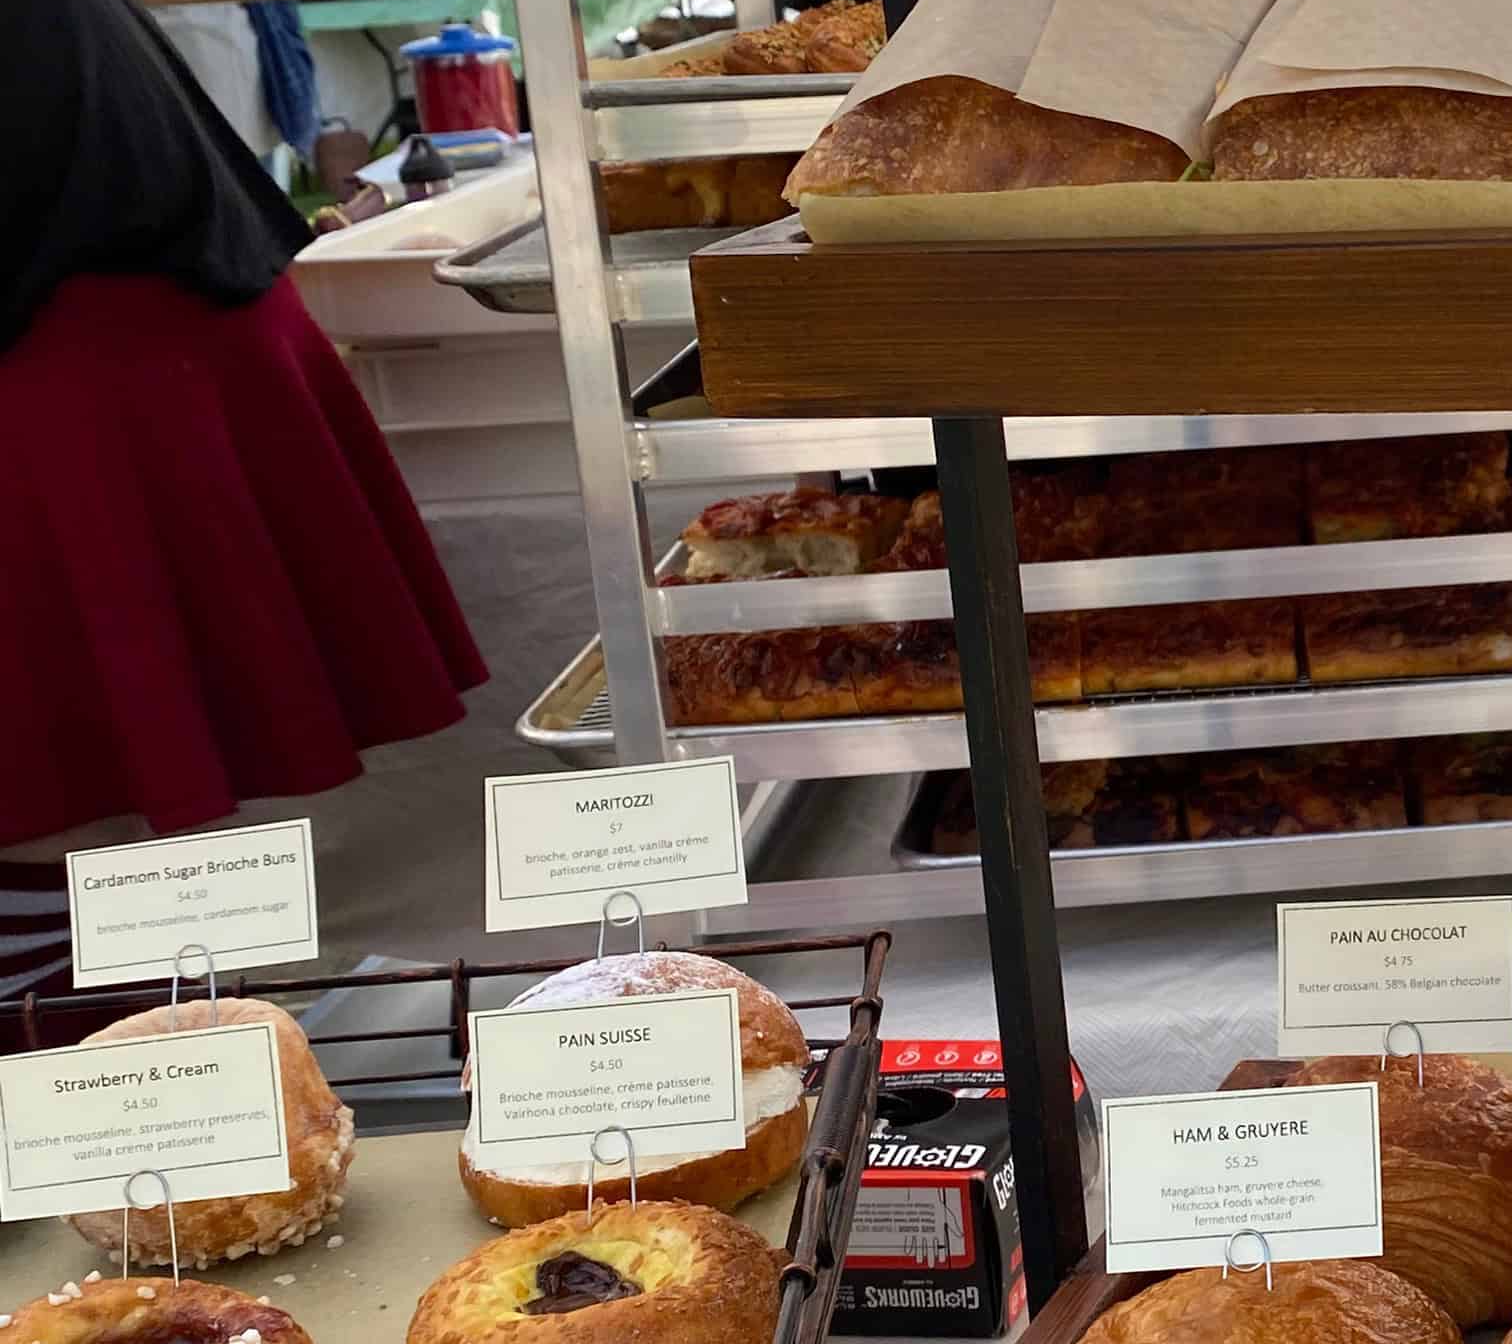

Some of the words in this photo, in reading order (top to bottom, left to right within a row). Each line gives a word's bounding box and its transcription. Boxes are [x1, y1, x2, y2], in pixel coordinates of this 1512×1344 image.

[575, 792, 654, 813] MARITOZZI
[608, 821, 623, 835] $7
[570, 847, 609, 859] orange
[638, 838, 673, 852] vanilla
[83, 870, 160, 890] Cardamom
[163, 864, 203, 881] Sugar
[206, 855, 259, 874] Brioche
[262, 852, 296, 866] Buns
[1329, 929, 1363, 944] PAIN
[1365, 929, 1387, 943] AU
[1390, 925, 1467, 942] CHOCOLAT
[1383, 955, 1413, 968] $4.75
[1297, 982, 1331, 993] Butter
[1408, 976, 1448, 991] Belgian
[1448, 975, 1501, 987] chocolate
[558, 1032, 595, 1048] PAIN
[598, 1026, 651, 1045] SUISSE
[589, 1057, 623, 1073] $4.50
[53, 1071, 144, 1093] Strawberry
[148, 1066, 162, 1081] &
[166, 1062, 219, 1079] Cream
[122, 1096, 158, 1112] $4.50
[498, 1090, 543, 1104] Brioche
[557, 1100, 617, 1116] chocolate,
[620, 1098, 654, 1110] crispy
[138, 1117, 206, 1135] strawberry
[1172, 1126, 1212, 1144] HAM
[1216, 1124, 1230, 1141] &
[1234, 1119, 1308, 1139] GRUYERE
[71, 1145, 112, 1161] vanilla
[156, 1134, 215, 1152] patisserie
[1224, 1154, 1259, 1170] $5.25
